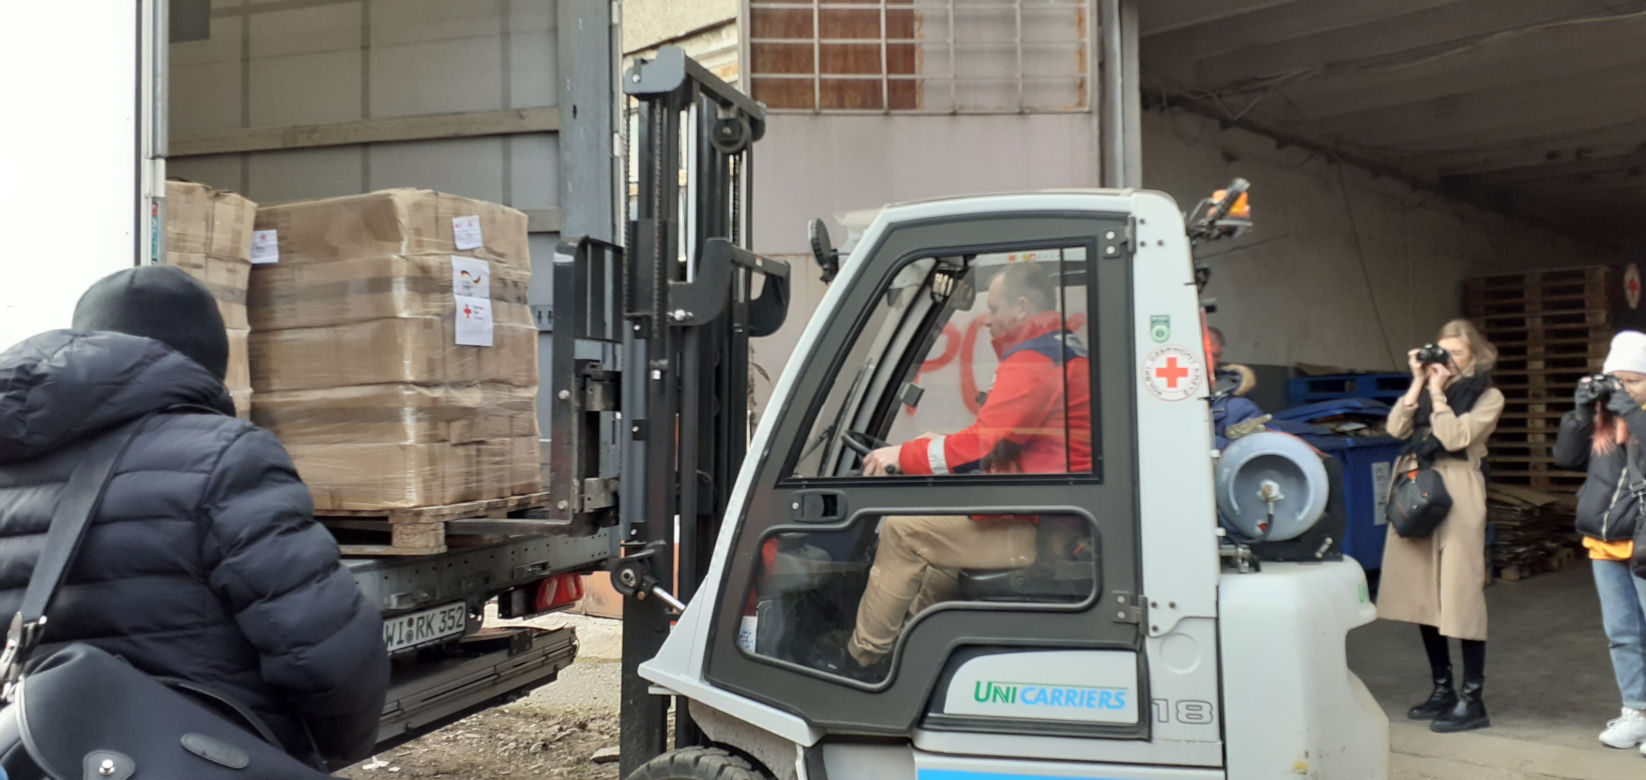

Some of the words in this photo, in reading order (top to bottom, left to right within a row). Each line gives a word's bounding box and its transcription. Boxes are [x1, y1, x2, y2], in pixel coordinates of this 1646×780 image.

[385, 621, 404, 648] WI
[416, 613, 435, 640] RK
[439, 606, 464, 634] 352
[1020, 686, 1129, 710] CARRIERS
[1151, 698, 1214, 725] 18
